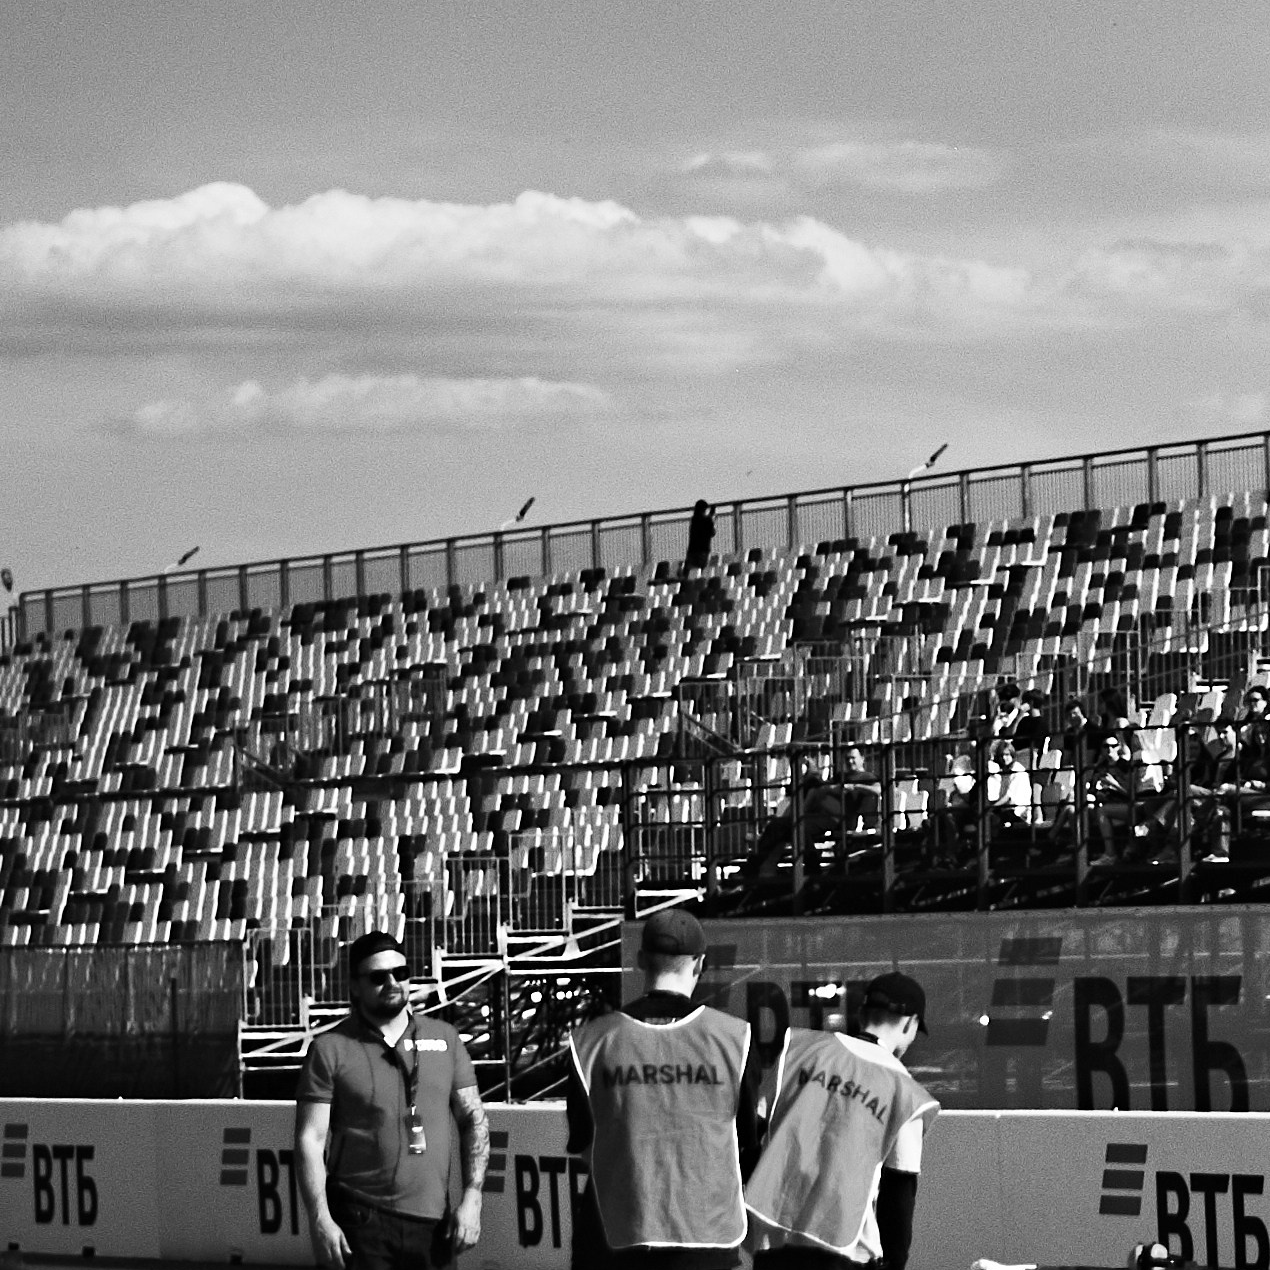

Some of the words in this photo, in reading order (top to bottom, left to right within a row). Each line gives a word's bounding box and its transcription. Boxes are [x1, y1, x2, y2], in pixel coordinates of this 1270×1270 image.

[602, 1063, 724, 1088] MARSHAL
[1074, 975, 1249, 1112] ВТБ
[32, 1145, 98, 1225] ВТБ
